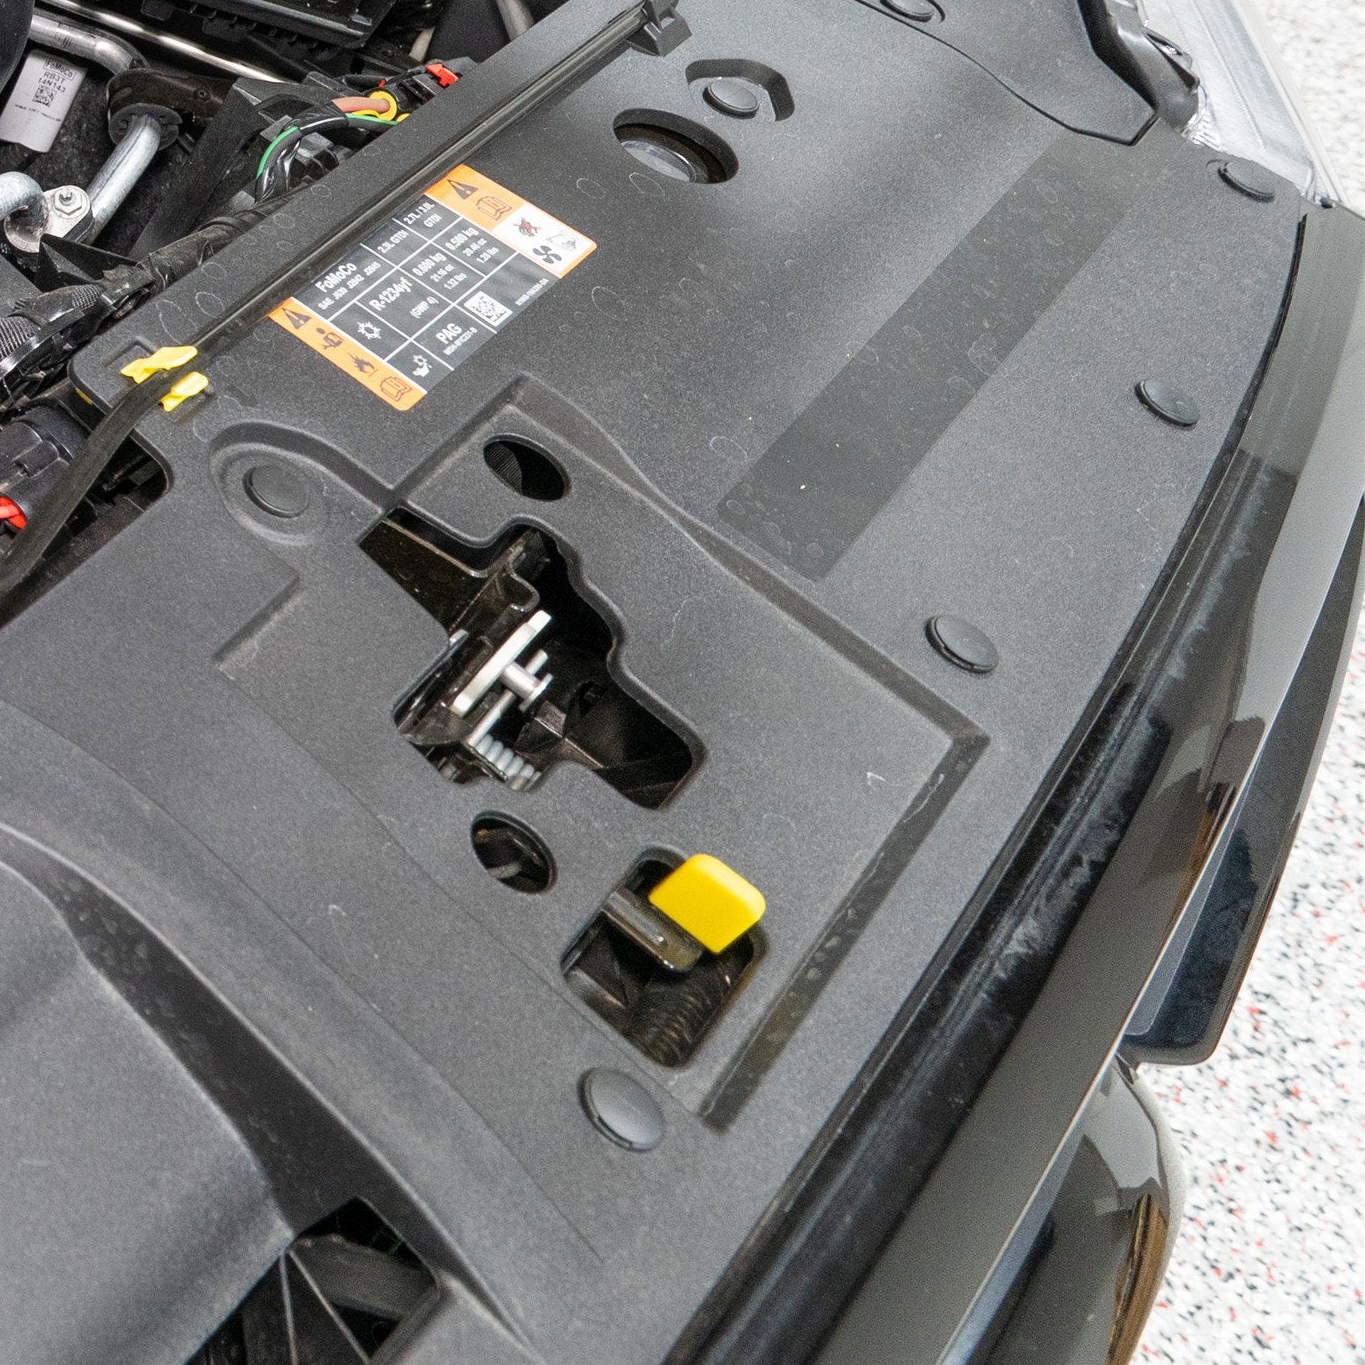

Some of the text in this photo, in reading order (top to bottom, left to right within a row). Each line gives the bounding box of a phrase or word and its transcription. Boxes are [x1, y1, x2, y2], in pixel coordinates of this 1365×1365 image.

[45, 59, 73, 78] FoMoCo
[424, 214, 442, 227] GTDI
[377, 230, 409, 253] 2.3L GTDI
[462, 227, 479, 237] kg
[429, 253, 447, 262] kg
[315, 263, 357, 292] FoMoCo
[318, 298, 334, 309] SAE
[369, 277, 412, 311] R-1234yf
[436, 323, 462, 344] PAG
